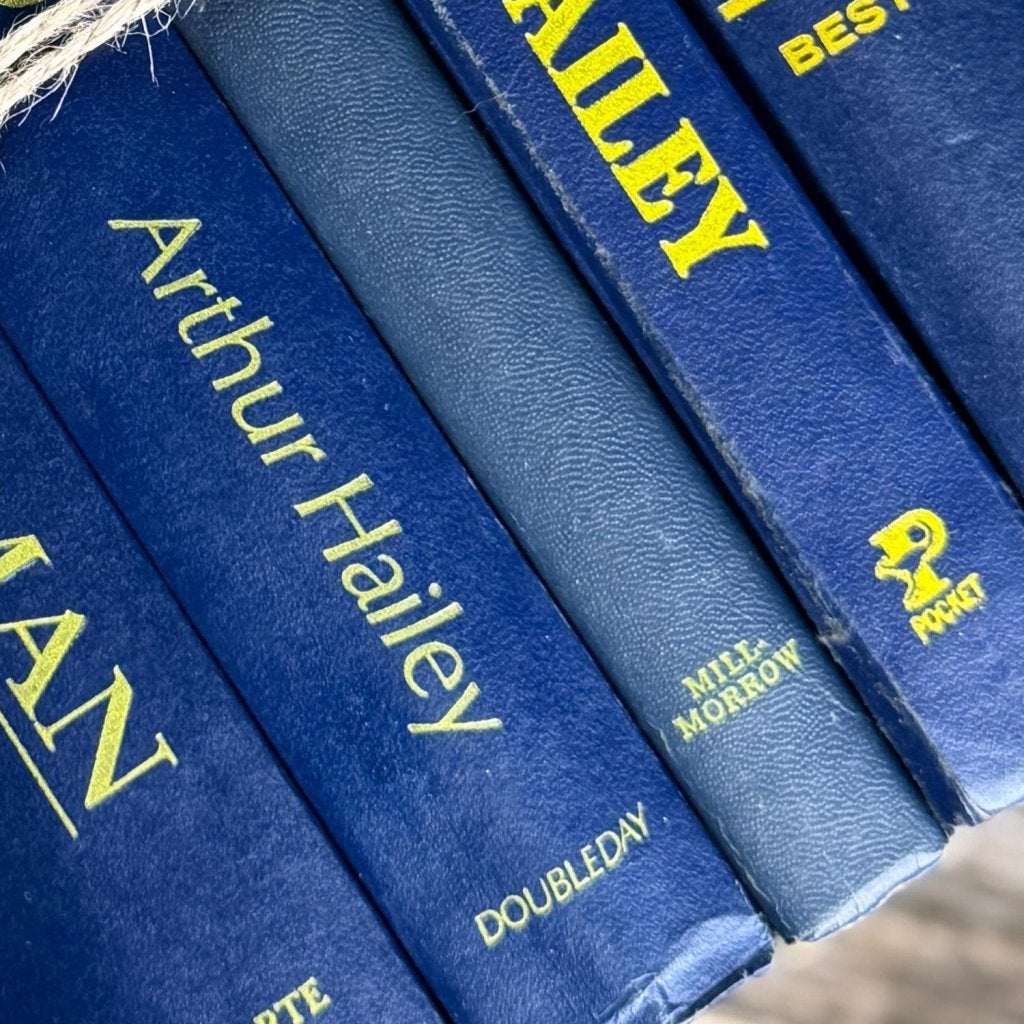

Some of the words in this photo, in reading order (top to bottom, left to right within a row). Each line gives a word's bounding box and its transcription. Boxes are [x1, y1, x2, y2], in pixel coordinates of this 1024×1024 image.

[107, 216, 328, 467] Arthur
[293, 473, 504, 736] Hailey
[909, 572, 987, 646] POCKET
[671, 638, 802, 742] MORROW
[474, 802, 650, 948] DOUBLEDAY
